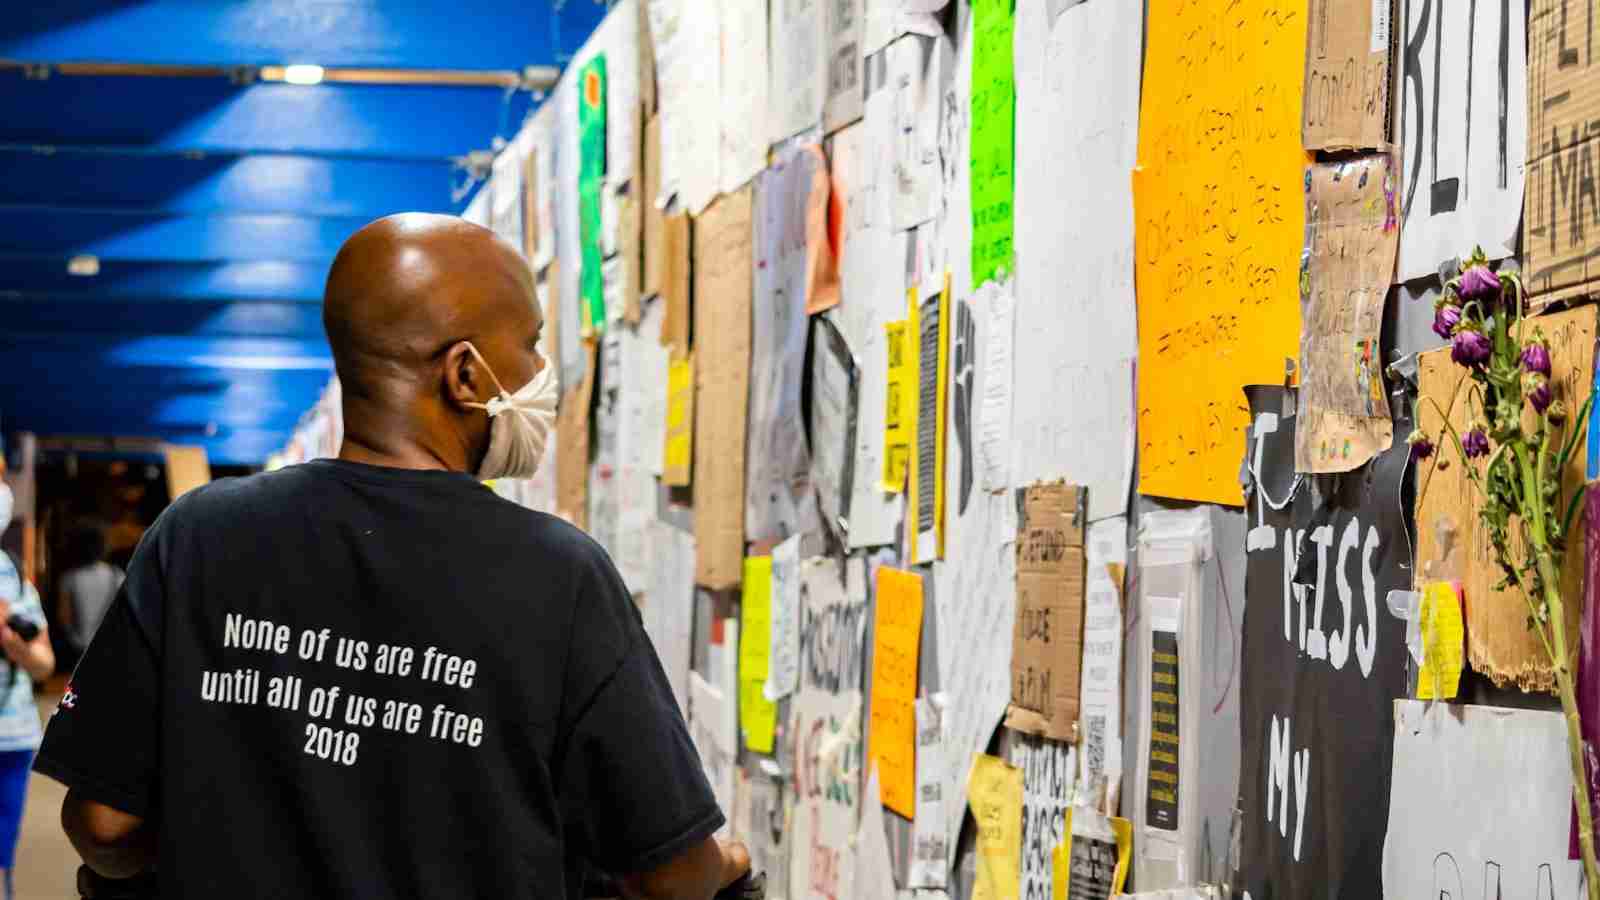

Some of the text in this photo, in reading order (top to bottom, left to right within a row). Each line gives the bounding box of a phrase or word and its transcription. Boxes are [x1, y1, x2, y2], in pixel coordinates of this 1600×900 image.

[1247, 412, 1279, 552] I
[1283, 516, 1380, 679] MISS
[224, 613, 477, 689] None of us are free
[201, 668, 484, 748] until all of us are free
[304, 722, 360, 766] 2018
